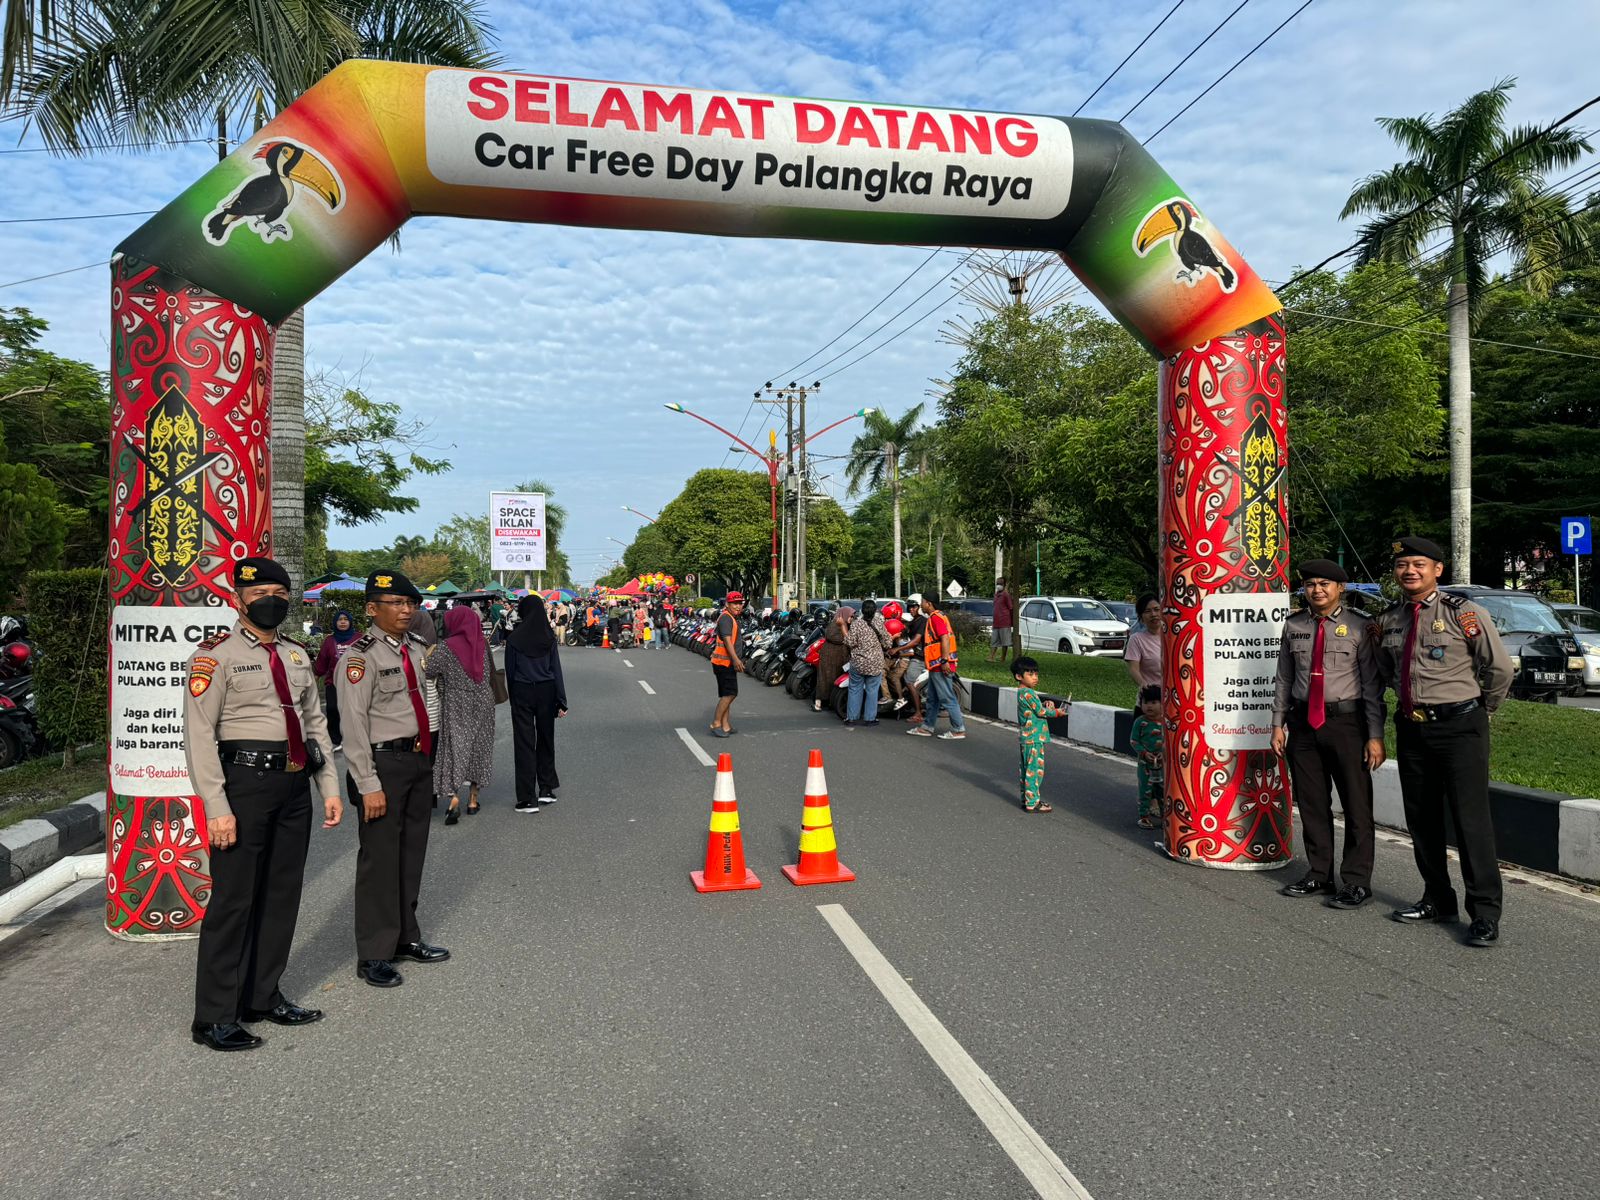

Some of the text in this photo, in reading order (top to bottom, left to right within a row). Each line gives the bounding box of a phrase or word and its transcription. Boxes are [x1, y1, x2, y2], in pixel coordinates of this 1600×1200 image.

[467, 77, 1038, 158] SELAMAT DATANG
[475, 132, 1032, 206] Car Free Day Palangka Raya
[499, 508, 536, 517] SPACE
[500, 518, 533, 527] IKLAN
[1568, 522, 1585, 547] P
[1210, 608, 1268, 623] MITRA
[116, 624, 177, 642] MITRA
[1214, 638, 1261, 647] DATANG
[1214, 651, 1262, 659] PULANG
[118, 660, 166, 671] DATANG
[233, 664, 262, 673] SURANTO
[118, 676, 166, 687] PULANG
[1223, 677, 1250, 687] Jaga
[1253, 676, 1269, 685] diri
[1228, 690, 1249, 698] dan
[1214, 702, 1239, 712] juga
[123, 708, 149, 720] Jaga
[153, 708, 177, 718] diri
[127, 723, 148, 733] dan
[1212, 724, 1245, 735] Selamat
[116, 737, 137, 750] juga
[114, 763, 144, 778] Selamat
